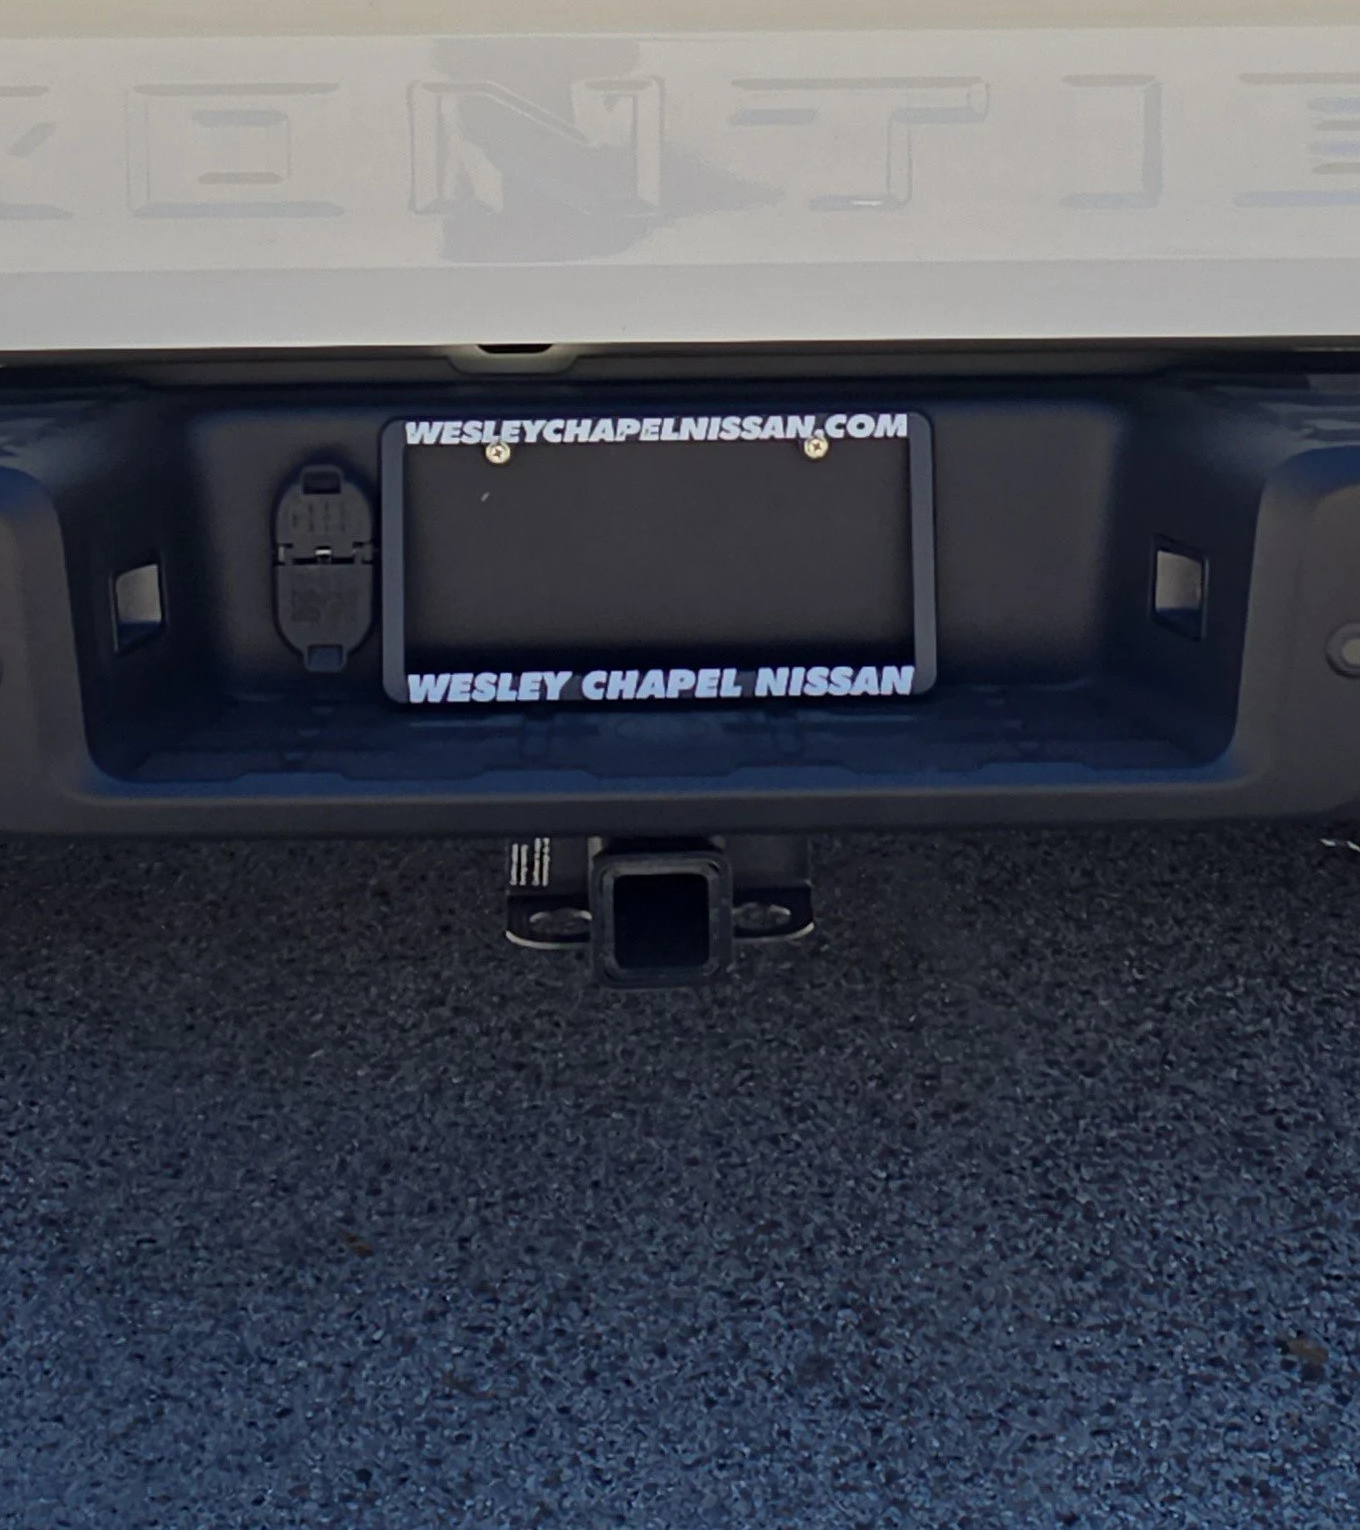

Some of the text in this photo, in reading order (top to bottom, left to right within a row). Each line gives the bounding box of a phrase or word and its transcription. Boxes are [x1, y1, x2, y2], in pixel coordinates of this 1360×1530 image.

[404, 413, 909, 445] WESLEYCHAPELNISSAN.COM
[407, 665, 915, 704] WESLEY CHAPEL NISSAN
